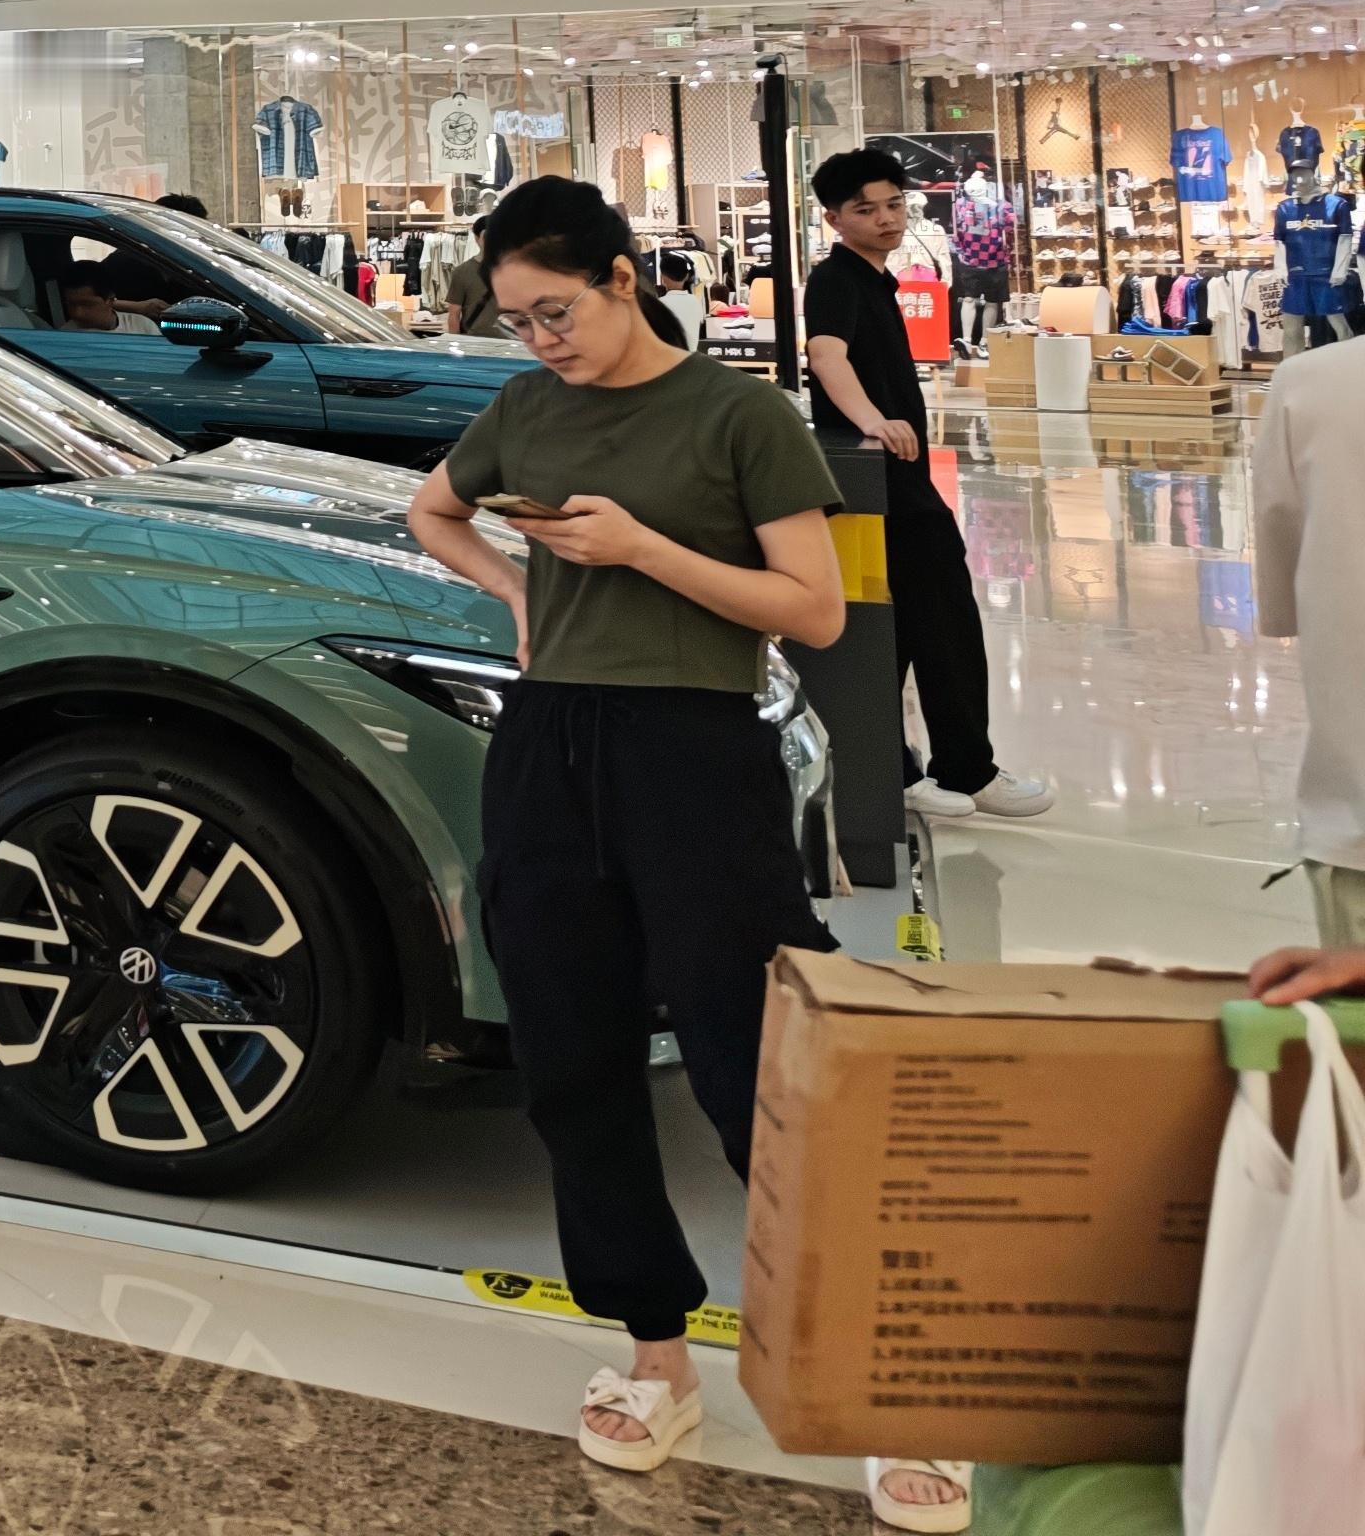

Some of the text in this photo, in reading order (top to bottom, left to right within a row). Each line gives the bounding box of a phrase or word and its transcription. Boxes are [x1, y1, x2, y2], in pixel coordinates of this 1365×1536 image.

[539, 1291, 570, 1303] WARM
[701, 1318, 720, 1330] THE
[721, 1320, 739, 1332] STE
